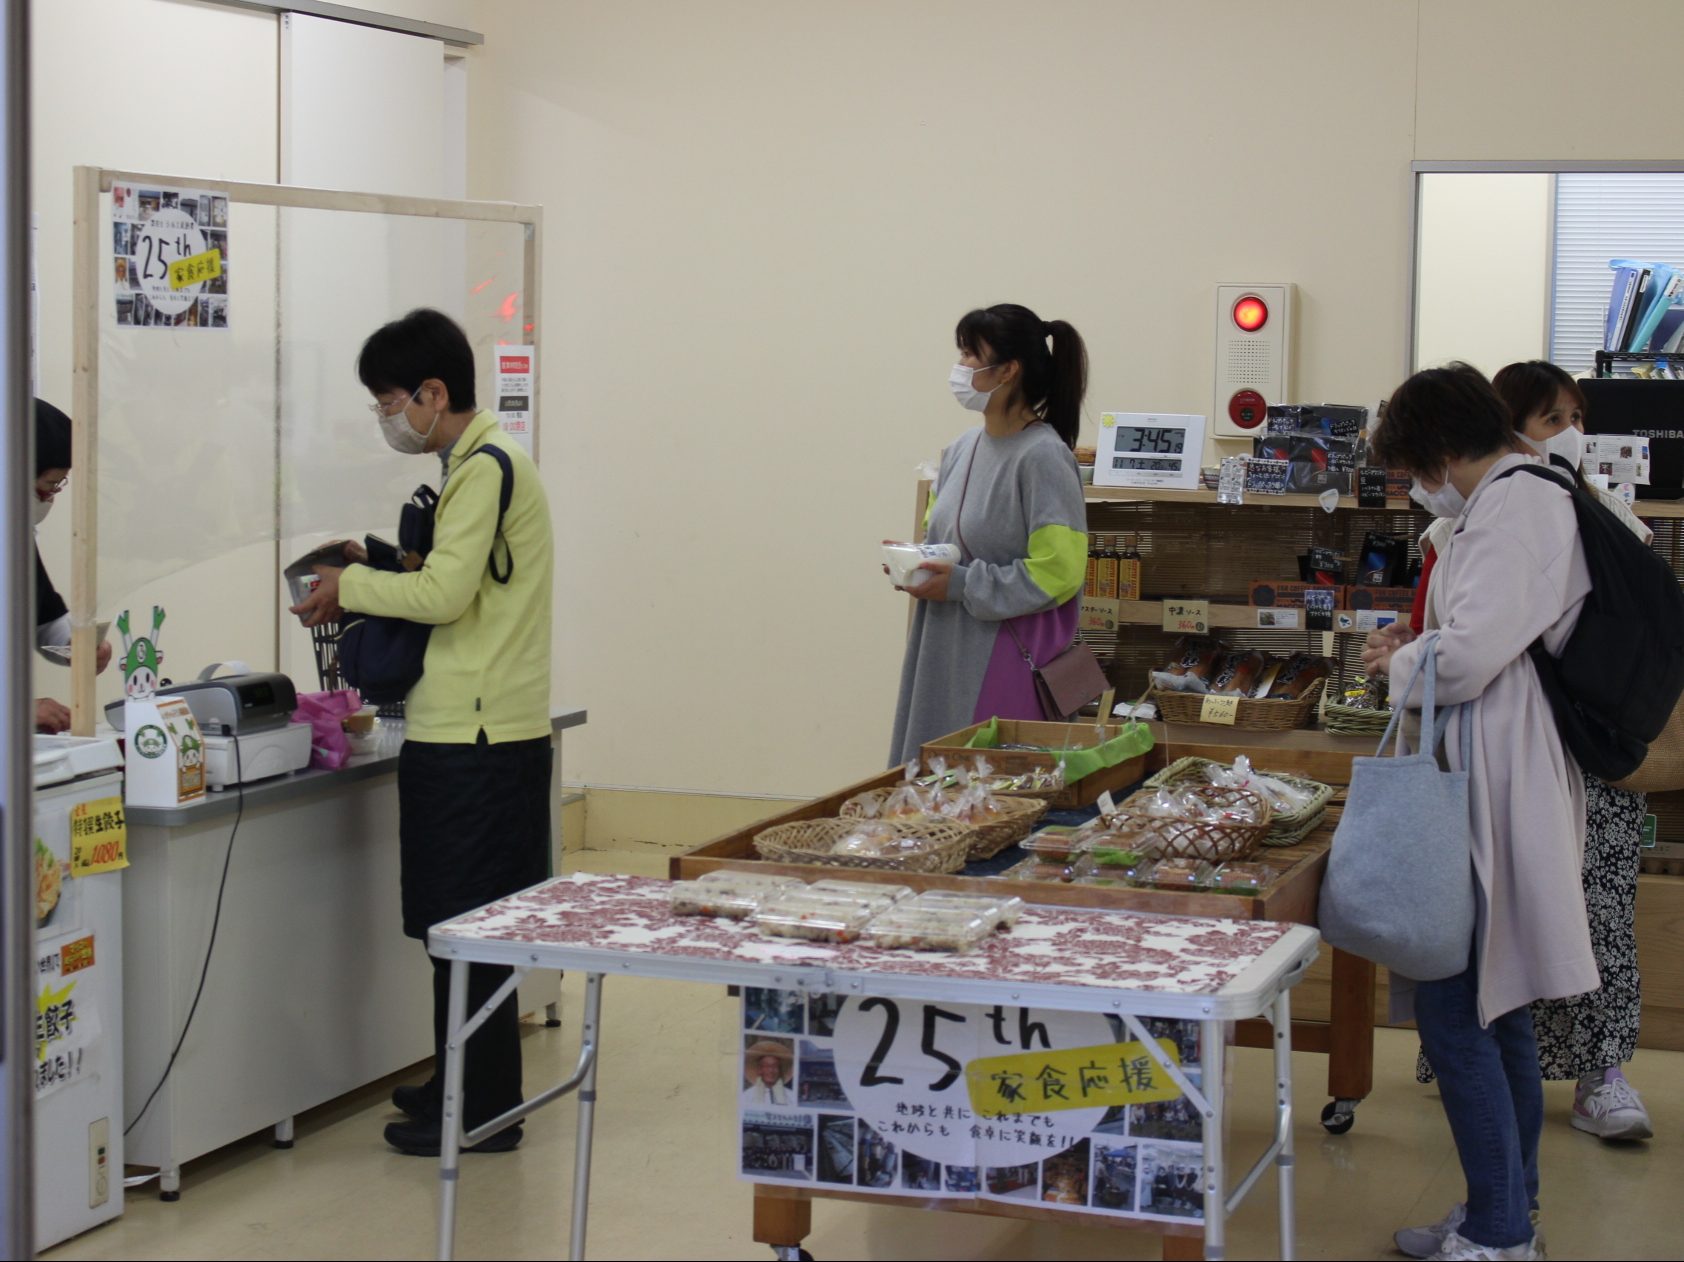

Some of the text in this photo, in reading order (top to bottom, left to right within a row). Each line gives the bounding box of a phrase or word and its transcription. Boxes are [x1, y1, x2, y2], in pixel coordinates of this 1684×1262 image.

[142, 233, 192, 280] 25th
[1130, 428, 1172, 453] 3:45
[1632, 429, 1684, 439] TOSHIBA
[858, 996, 1052, 1092] 25th
[990, 1055, 1158, 1104] 家食応援
[876, 1120, 950, 1138] これからも
[980, 1109, 1055, 1128] これまでも
